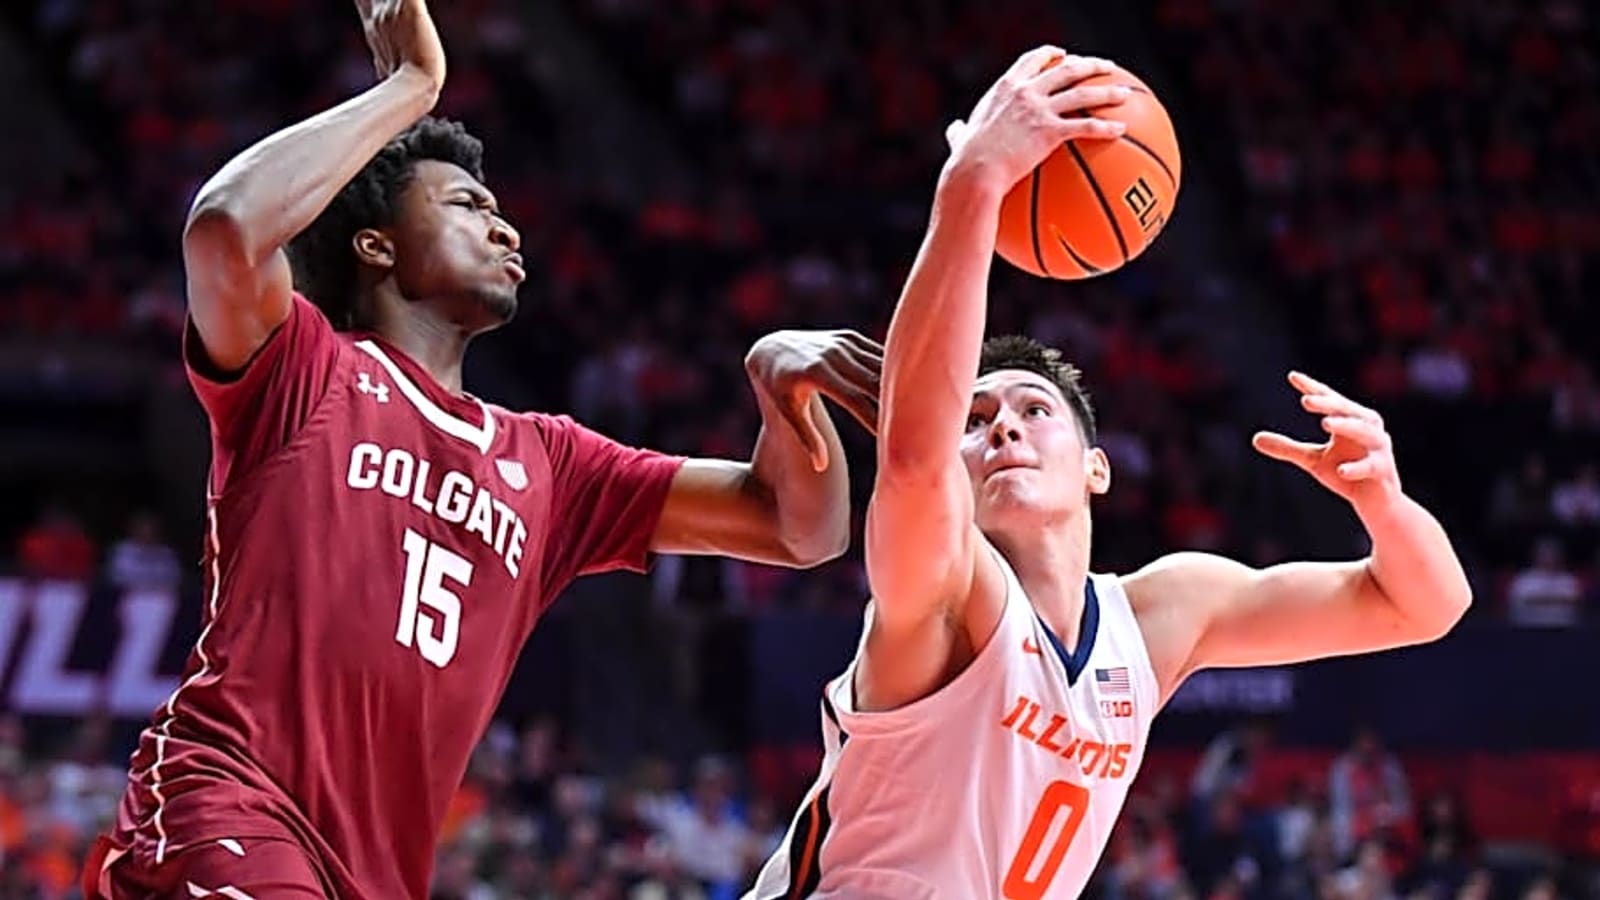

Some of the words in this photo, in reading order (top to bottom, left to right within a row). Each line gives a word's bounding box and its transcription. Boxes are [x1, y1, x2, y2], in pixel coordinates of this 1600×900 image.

[347, 442, 527, 579] COLGATE
[395, 527, 474, 668] 15
[1001, 696, 1132, 779] ILLIOIS
[1003, 780, 1089, 900] 0
